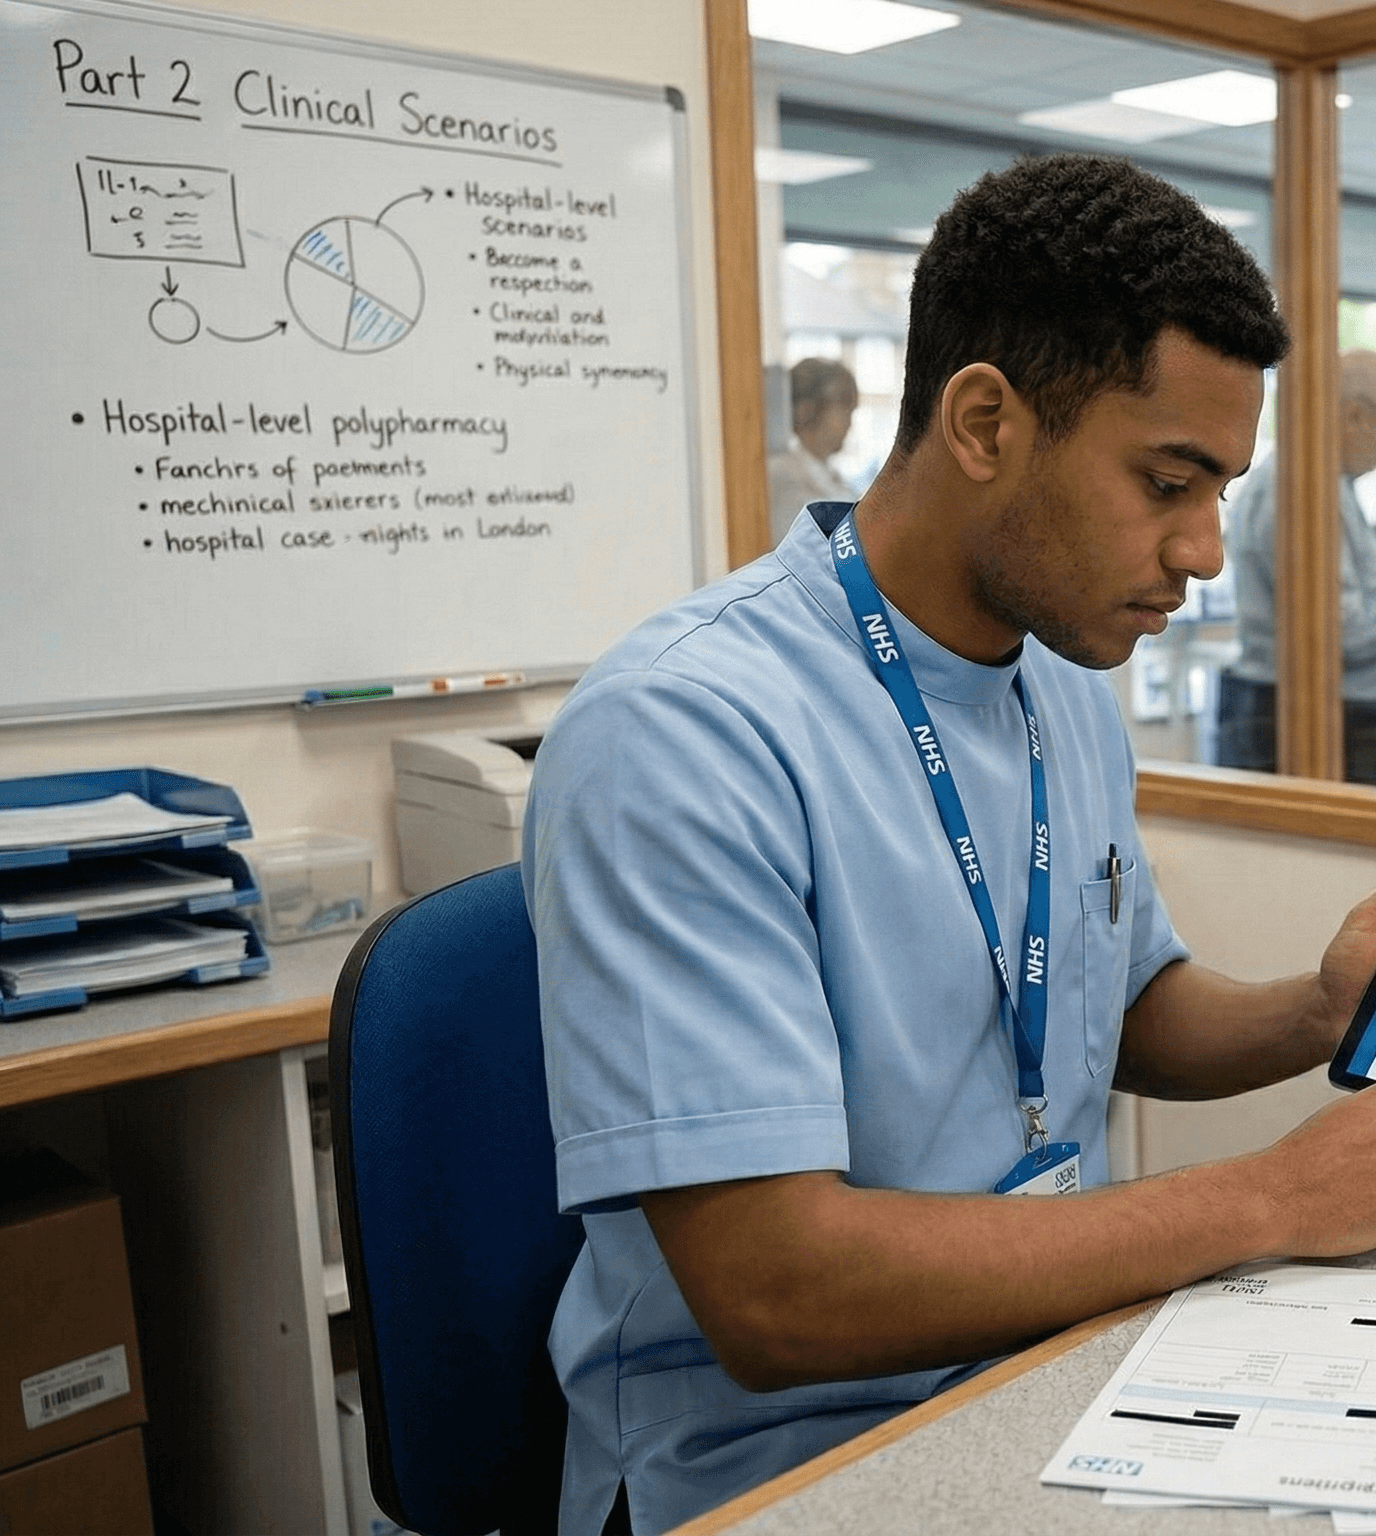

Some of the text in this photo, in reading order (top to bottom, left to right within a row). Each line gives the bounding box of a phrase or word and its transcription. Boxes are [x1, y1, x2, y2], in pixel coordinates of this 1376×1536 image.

[53, 38, 559, 153] Part 2 Clinical Scenarios
[464, 180, 617, 221] Hospital-level
[489, 301, 607, 326] Clinical and
[494, 354, 571, 388] Physical
[102, 396, 509, 454] Hospital-level polypharmacy
[272, 455, 297, 486] of
[164, 524, 266, 561] hospital
[280, 529, 336, 549] case
[441, 521, 465, 543] in
[475, 515, 552, 541] London
[834, 521, 857, 560] NHS
[862, 613, 899, 664] NHS
[913, 725, 946, 776] NHS
[956, 836, 983, 885] NHS
[1035, 821, 1049, 871] NHS
[1026, 935, 1045, 985] NHS
[1073, 1457, 1138, 1475] NHS
